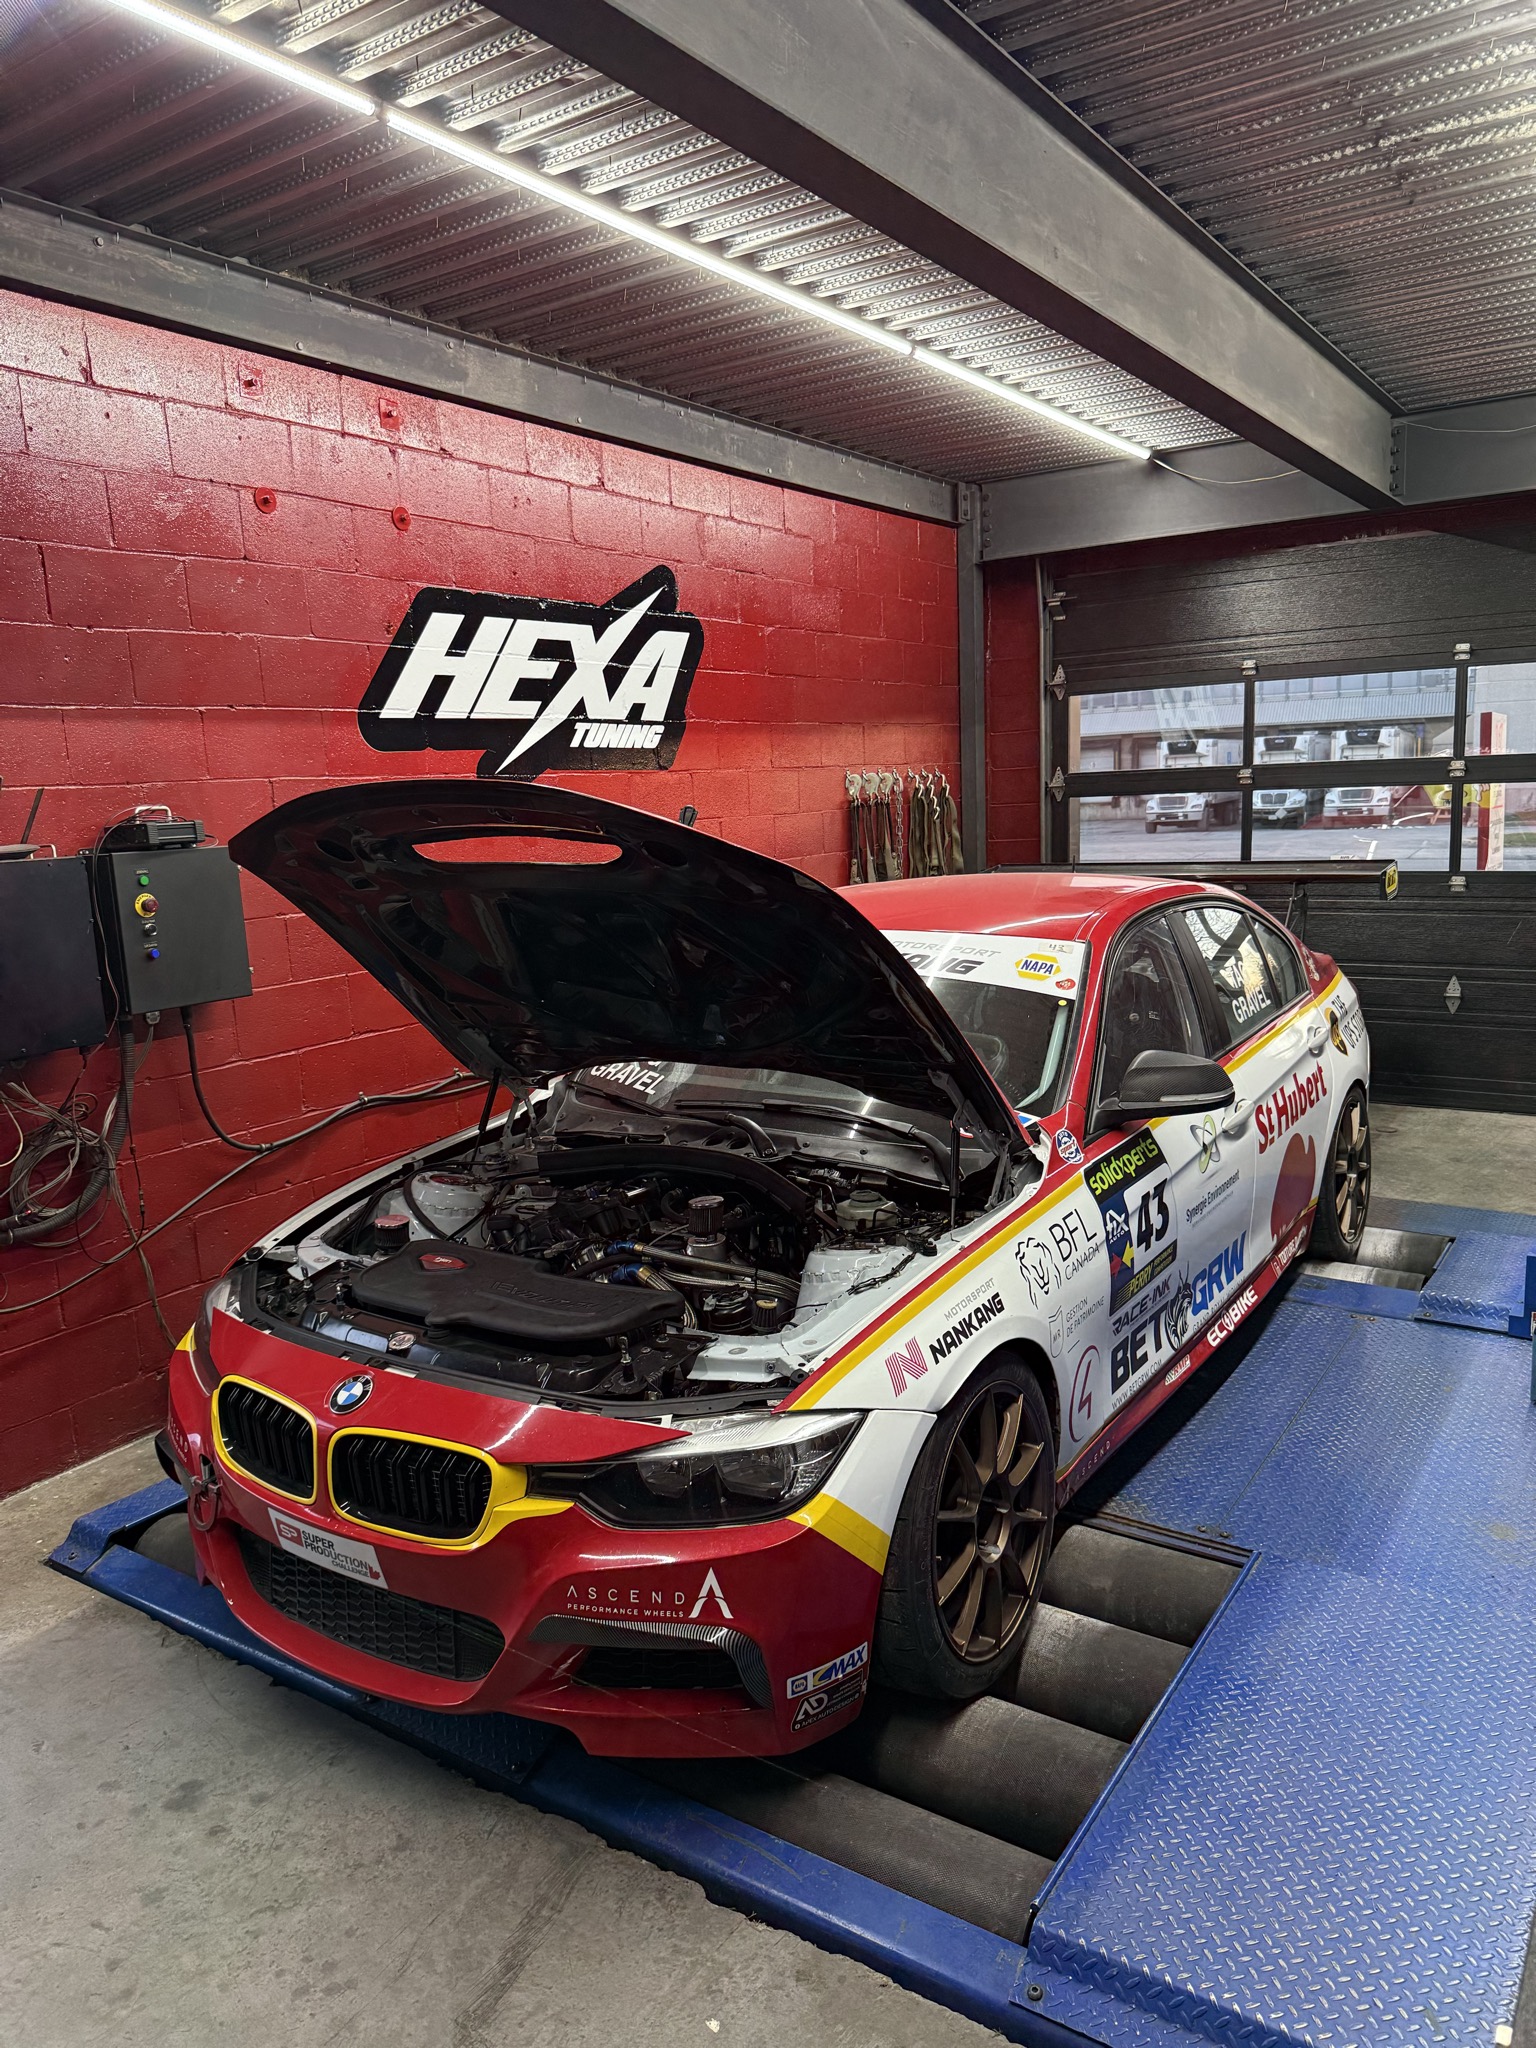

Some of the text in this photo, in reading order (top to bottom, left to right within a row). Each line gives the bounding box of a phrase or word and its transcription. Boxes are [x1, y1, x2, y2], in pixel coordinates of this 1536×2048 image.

[378, 584, 690, 775] HEXA
[569, 721, 666, 750] TUNING
[1020, 958, 1055, 976] NAPA
[1232, 985, 1272, 1024] GRAVEL
[590, 1061, 665, 1095] GRAVEL
[1271, 1061, 1328, 1140] Hubert
[1136, 1177, 1170, 1253] 43
[1048, 1208, 1098, 1262] BFL
[1064, 1241, 1101, 1281] CANADA
[1191, 1230, 1248, 1317] GRW
[943, 1277, 996, 1322] MOTORSPORT
[928, 1291, 1006, 1366] NANKANG
[1110, 1301, 1168, 1396] BET
[301, 1530, 335, 1551] SUPER
[304, 1540, 369, 1571] PRODUCTION
[331, 1559, 370, 1578] CHALLENGE
[567, 1584, 685, 1605] ASCEND
[567, 1602, 685, 1619] PERFORMANCE WHEELS
